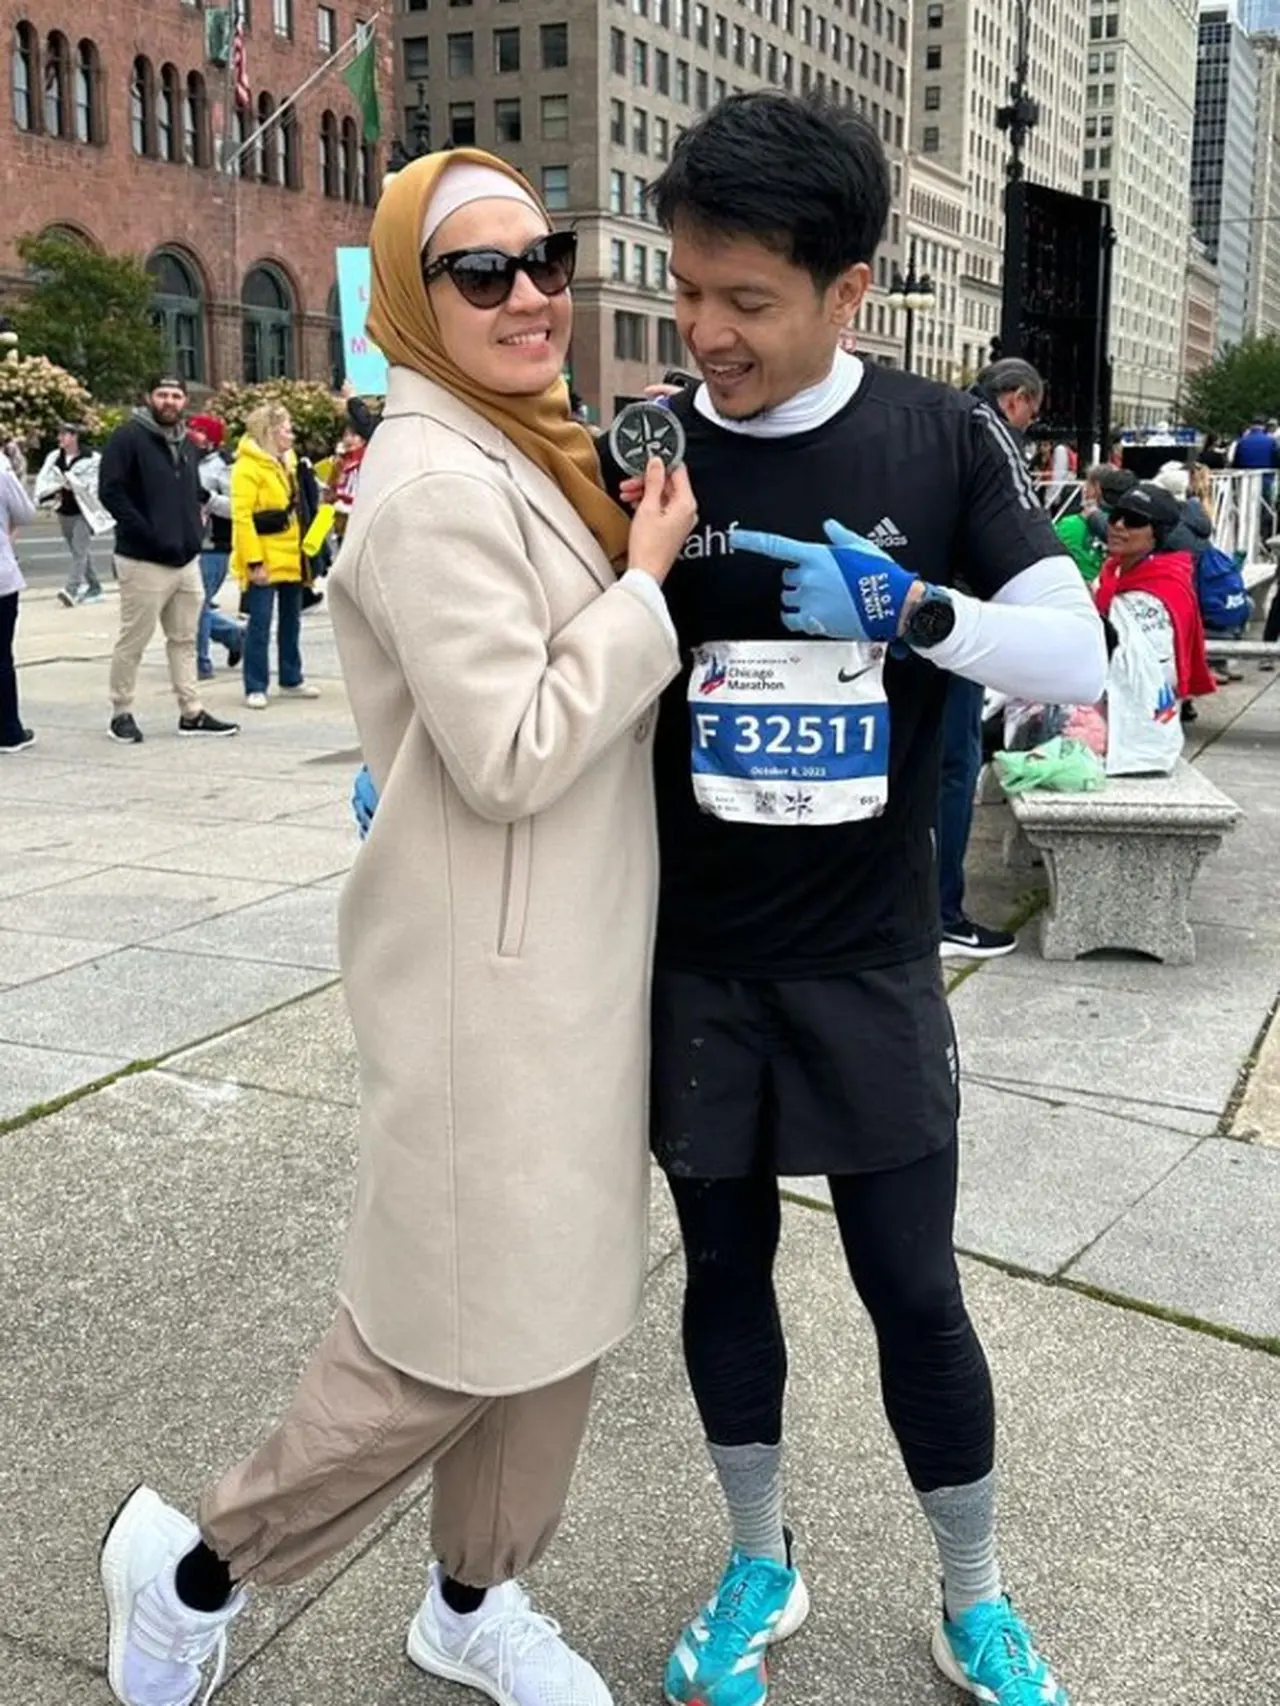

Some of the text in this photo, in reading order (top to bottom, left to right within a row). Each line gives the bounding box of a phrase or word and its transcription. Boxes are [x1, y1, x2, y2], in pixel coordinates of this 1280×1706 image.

[678, 521, 739, 560] ahf
[872, 536, 909, 547] didas
[728, 667, 775, 681] Chicago
[728, 680, 786, 691] Marathon
[696, 713, 876, 755] F 32511
